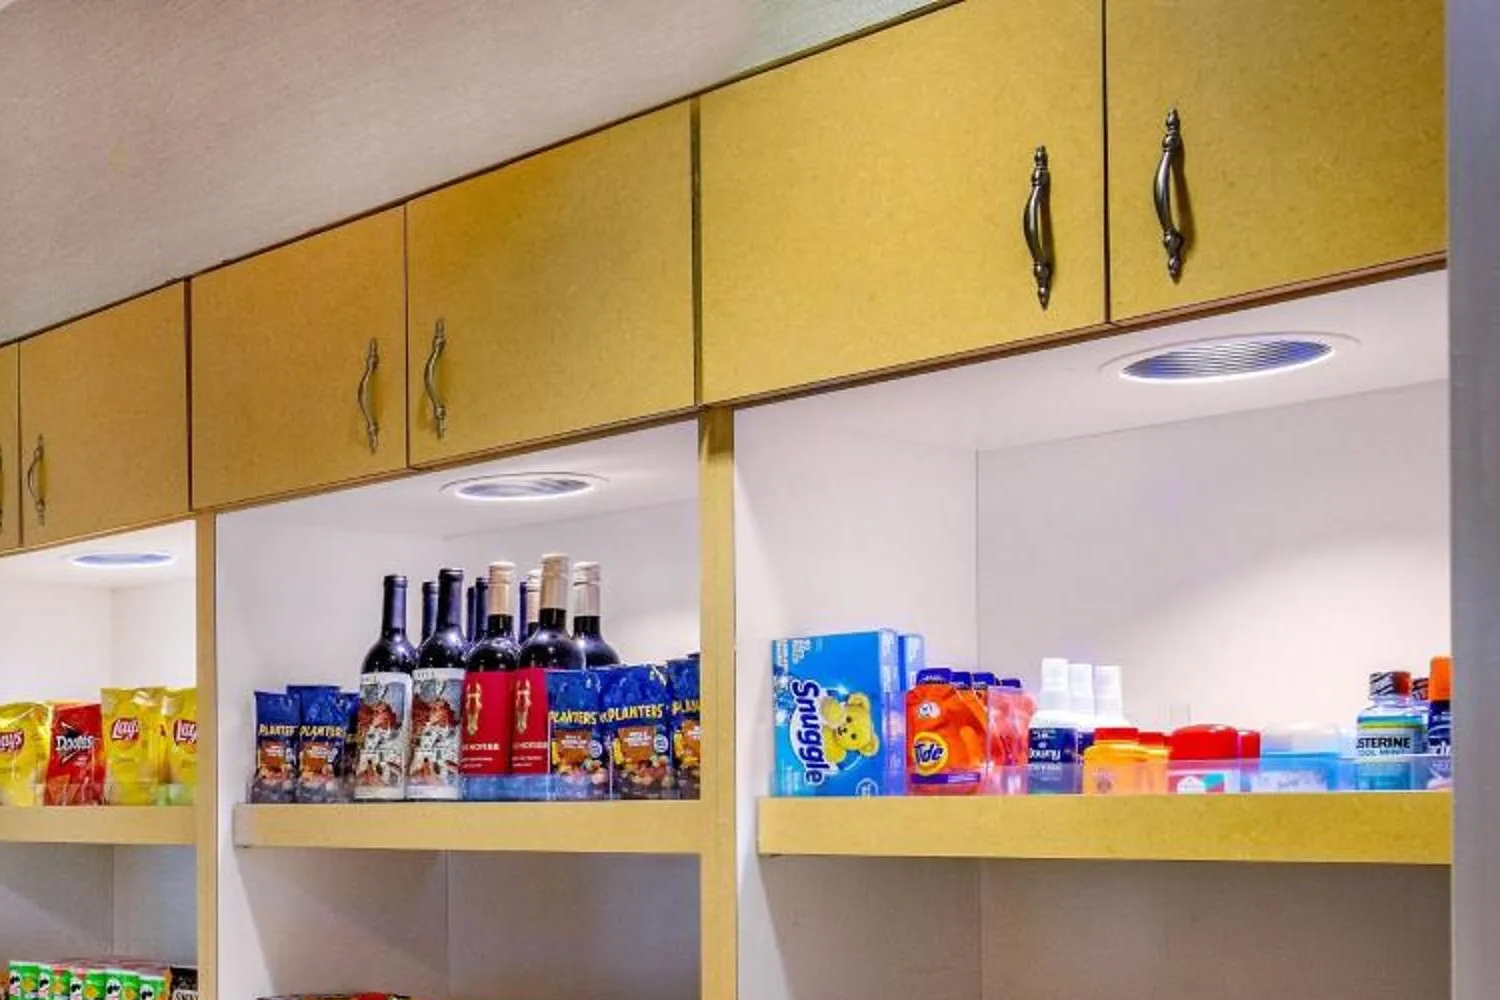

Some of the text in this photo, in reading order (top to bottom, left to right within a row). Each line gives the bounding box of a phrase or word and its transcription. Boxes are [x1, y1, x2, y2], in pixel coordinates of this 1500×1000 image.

[607, 704, 664, 722] PLANTERS
[791, 680, 831, 784] Snuggle
[913, 742, 943, 763] Tide
[1356, 737, 1412, 749] STERINE
